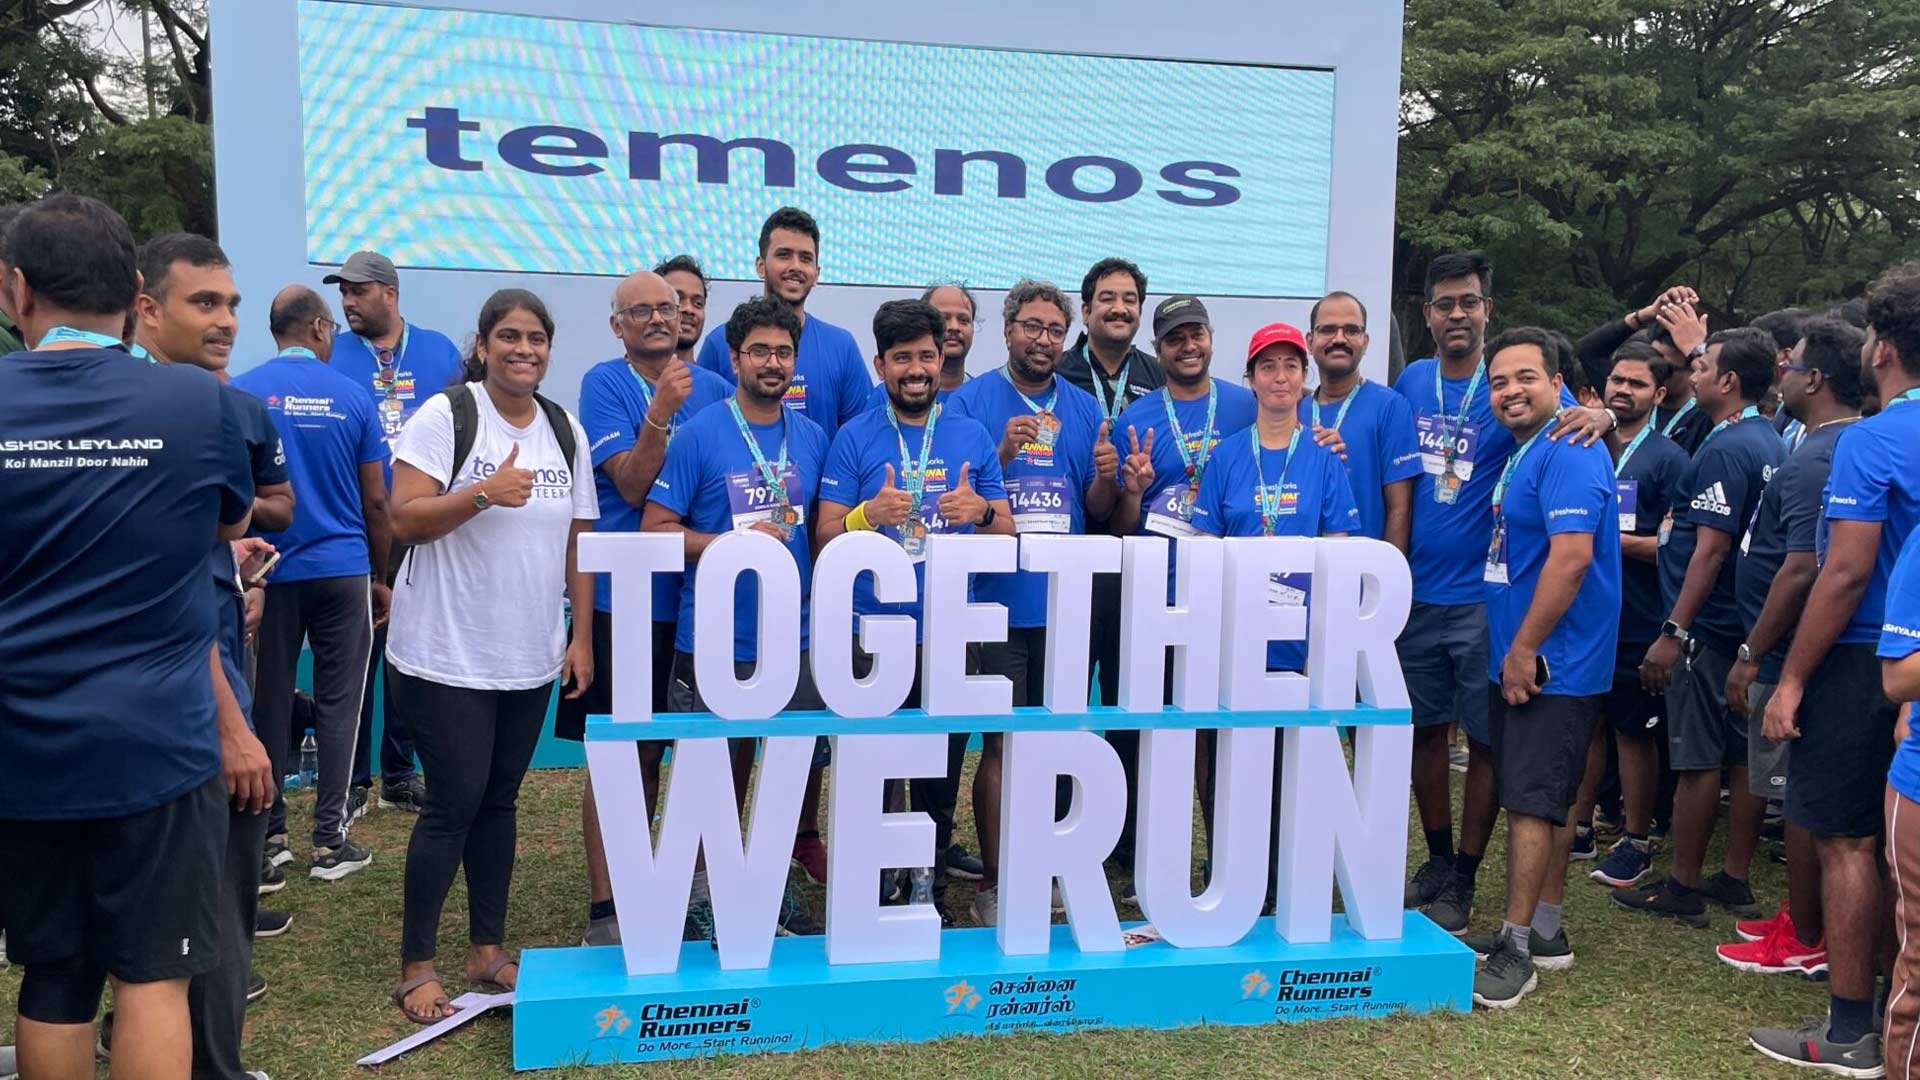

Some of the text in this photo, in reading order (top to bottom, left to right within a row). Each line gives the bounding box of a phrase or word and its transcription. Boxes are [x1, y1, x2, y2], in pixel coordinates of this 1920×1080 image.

[406, 107, 1242, 206] temenos
[68, 439, 163, 449] LEYLAND
[5, 456, 149, 469] Koi Manzil Door Nahin
[473, 456, 568, 484] tenos
[1010, 492, 1062, 508] 14436
[1691, 500, 1731, 516] adidas
[577, 531, 1413, 722] TOGETHER
[584, 724, 1413, 975] WE RUN
[988, 975, 1078, 996] சென்னை
[1277, 986, 1373, 1001] Runners
[985, 994, 1076, 1019] ரன்னர்ஸ்
[1275, 1005, 1290, 1015] Do
[639, 1019, 752, 1039] Runners
[637, 1043, 655, 1053] Do
